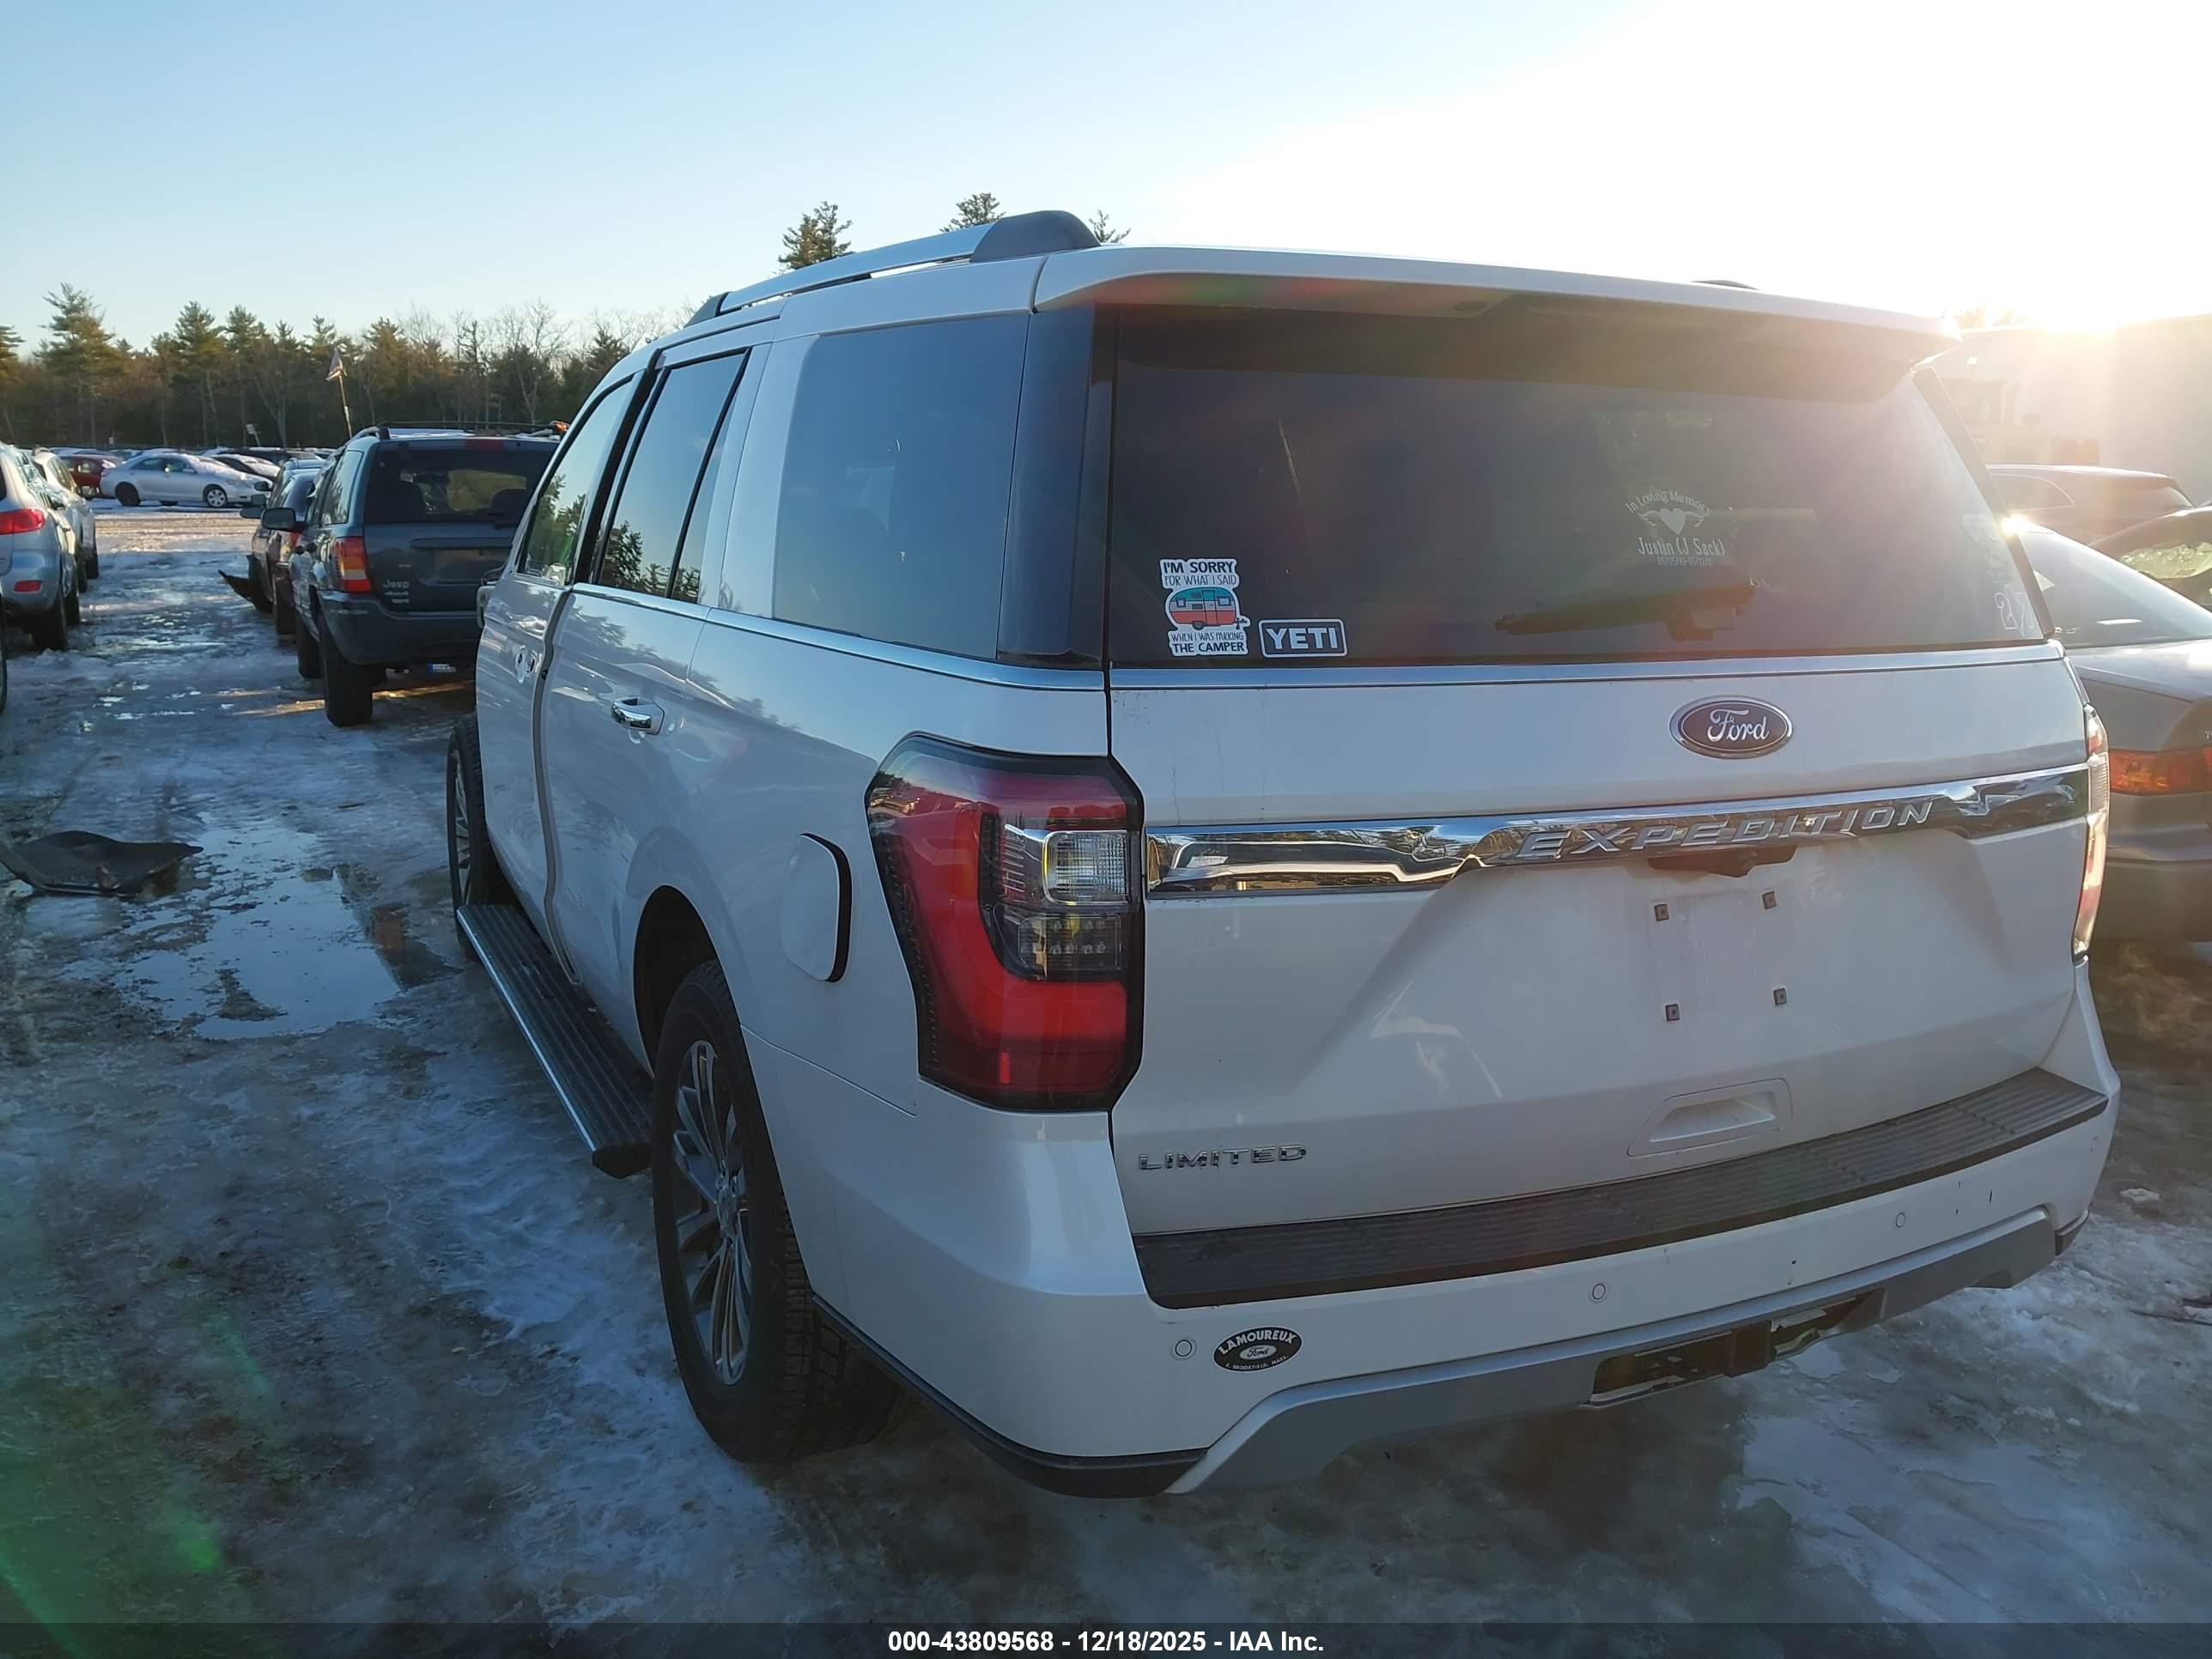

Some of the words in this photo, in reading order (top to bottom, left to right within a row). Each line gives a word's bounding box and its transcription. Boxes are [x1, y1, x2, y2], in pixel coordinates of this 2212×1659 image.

[1626, 501, 1638, 514] In
[1636, 490, 1668, 507] Loving
[1638, 537, 1676, 556] Justin
[1163, 562, 1184, 574] I'M
[1190, 561, 1234, 574] SORRY
[383, 579, 410, 589] Jeep
[1164, 575, 1182, 586] FOR
[1183, 574, 1209, 586] WHAT
[1218, 574, 1237, 586] SAID
[1171, 633, 1193, 642] WHEN
[1199, 632, 1214, 641] WAS
[1216, 631, 1244, 641] PARKING
[1265, 627, 1338, 649] YETI
[1172, 643, 1194, 653] THE
[1198, 641, 1245, 653] CAMPER
[1707, 708, 1770, 742] Ford
[1515, 799, 1936, 860] EXPEDITION
[1139, 1144, 1307, 1170] LIMITED
[1218, 1329, 1297, 1355] LAMOUREUX
[1247, 1346, 1270, 1358] Ford
